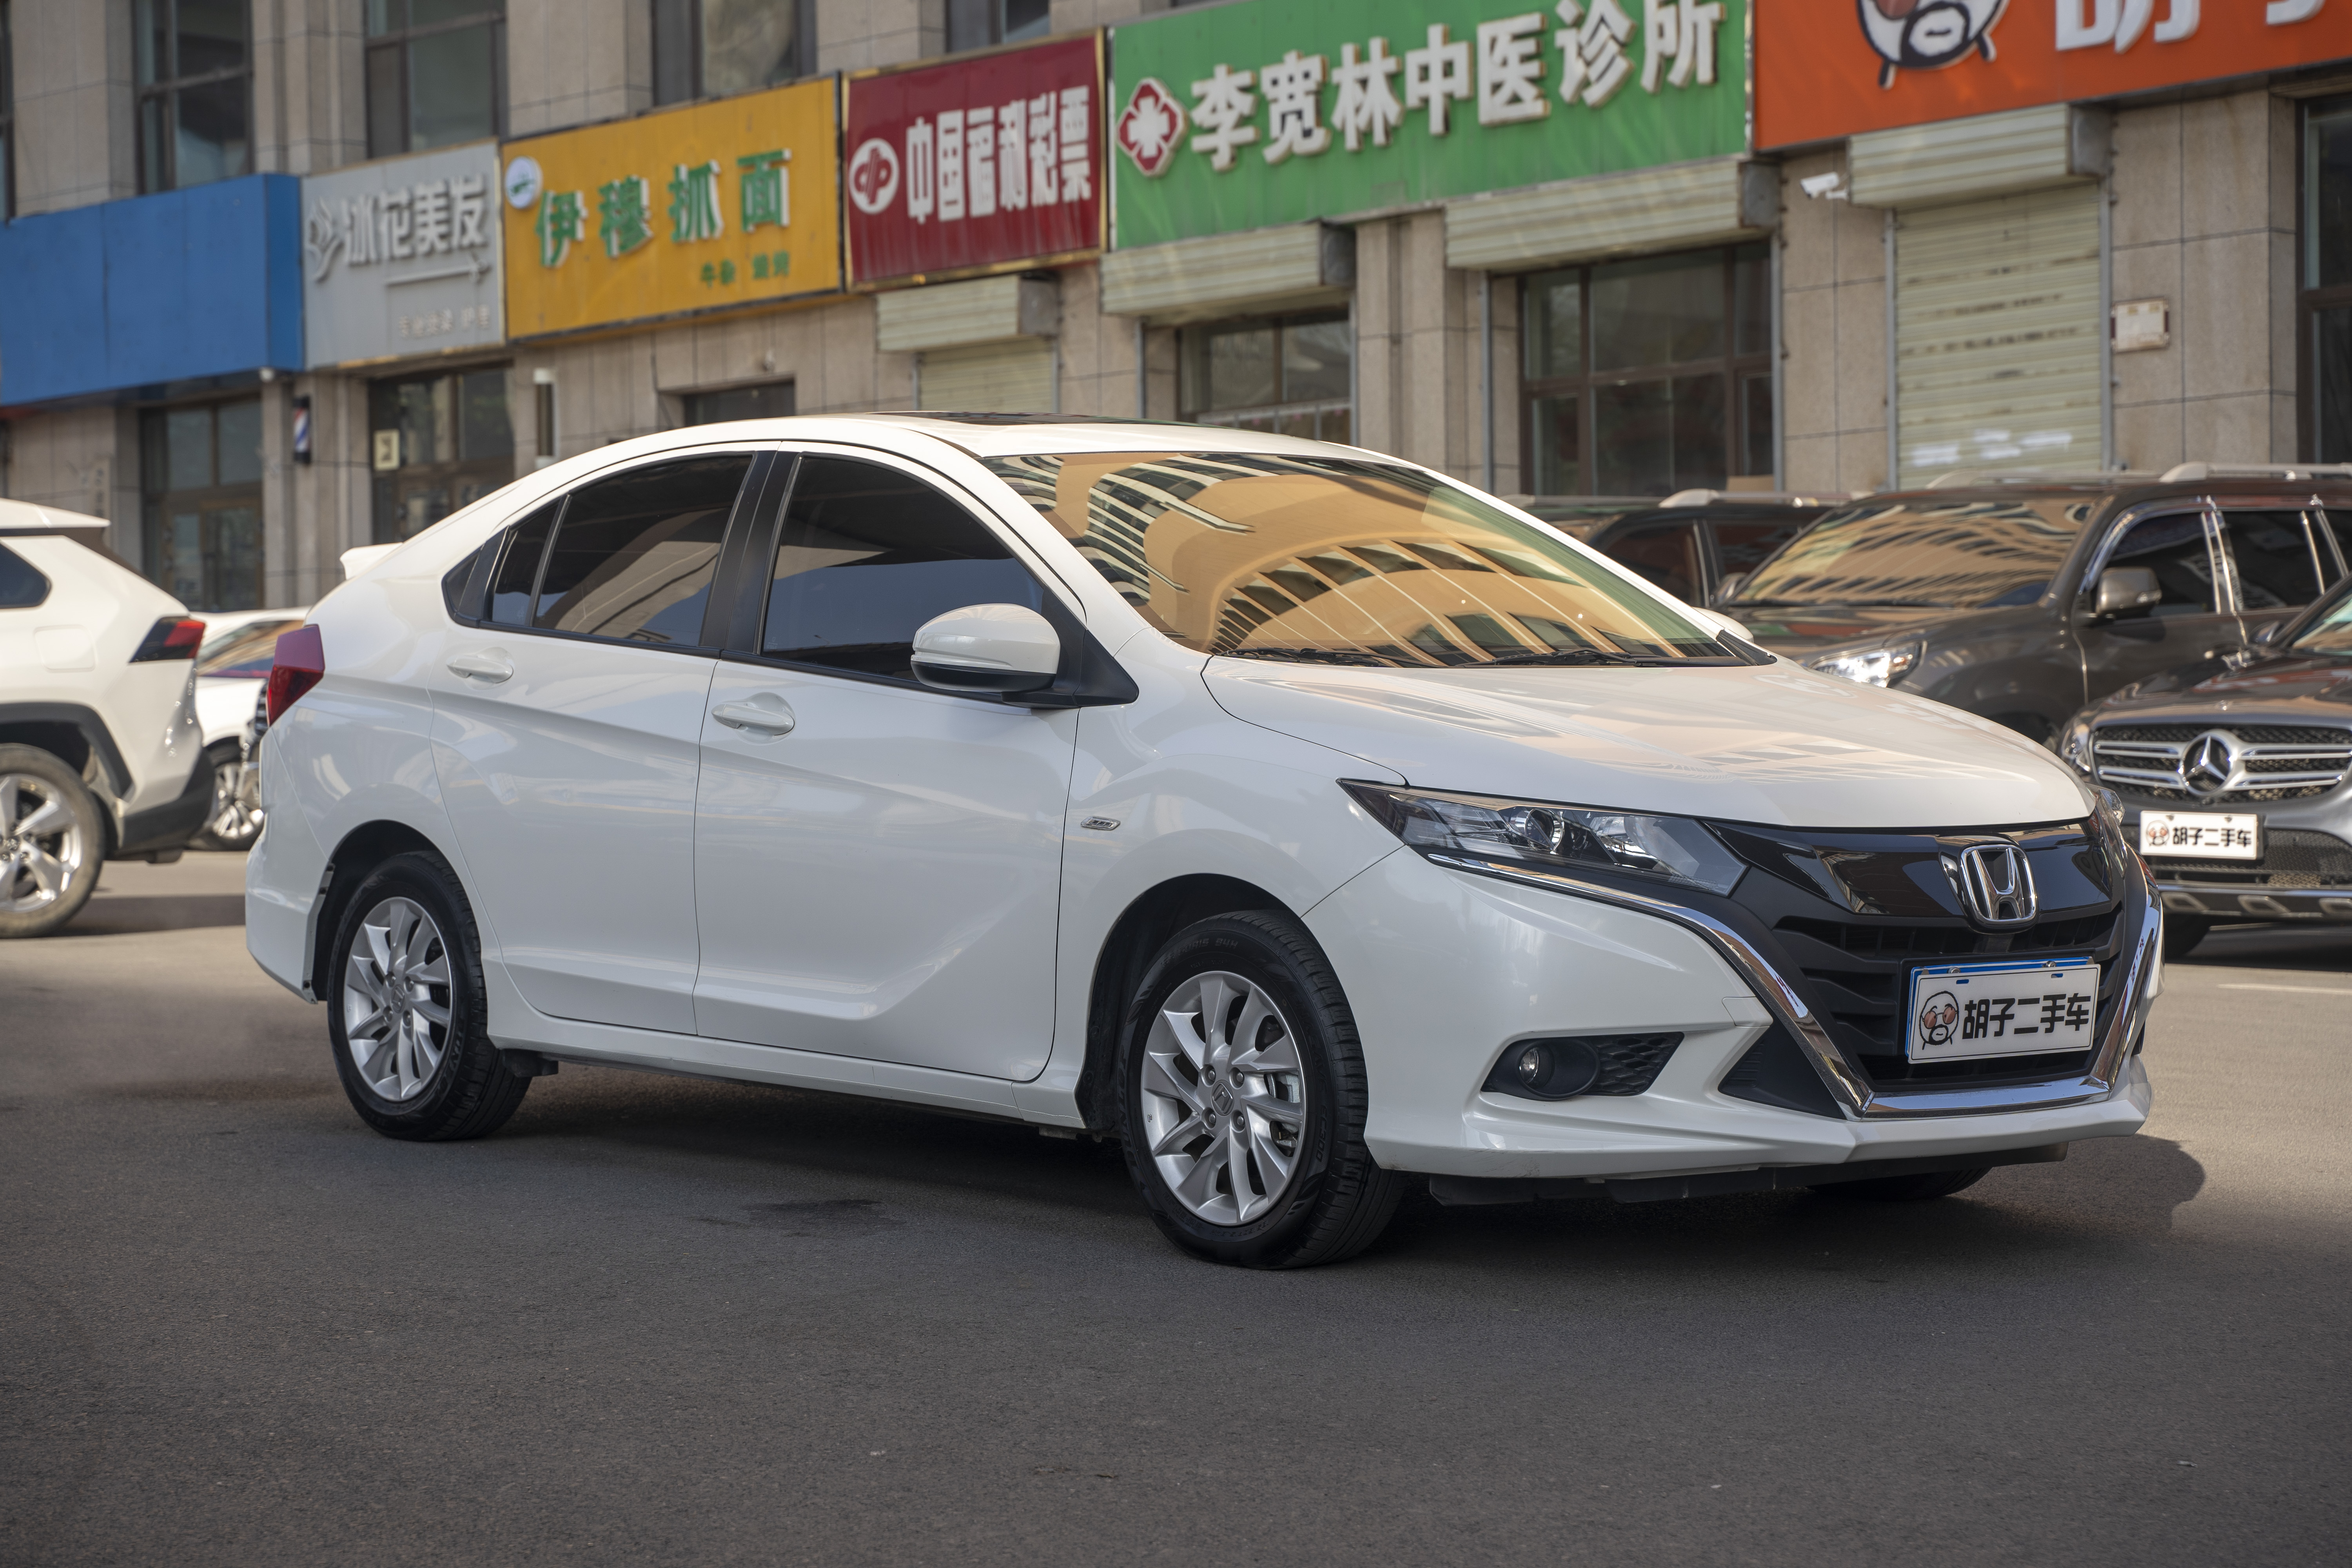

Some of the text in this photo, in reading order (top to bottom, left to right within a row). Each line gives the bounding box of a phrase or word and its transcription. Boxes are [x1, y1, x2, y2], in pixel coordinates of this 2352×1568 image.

[1190, 0, 1726, 172] 李宽林中医诊所
[906, 84, 1092, 225] 中国福利彩票
[2173, 826, 2252, 848] 胡子二手车
[1962, 993, 2092, 1040] 胡子二手车
